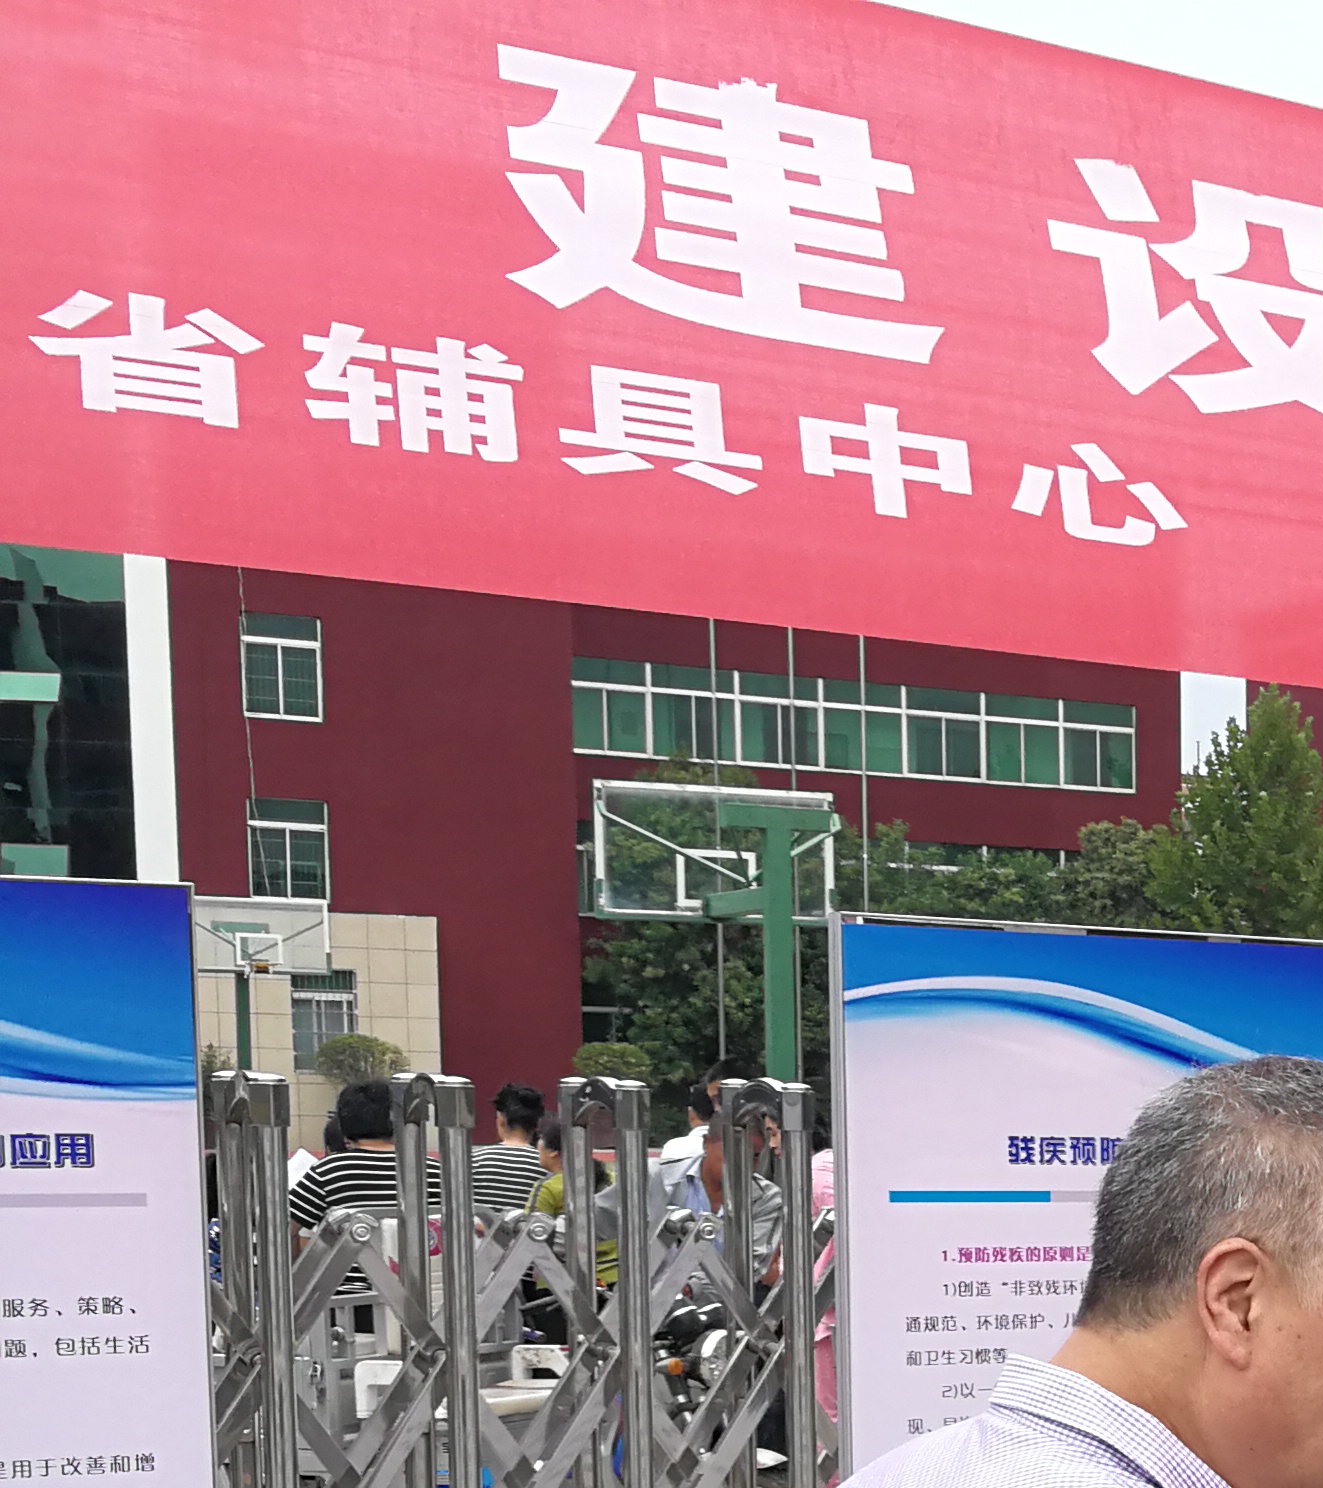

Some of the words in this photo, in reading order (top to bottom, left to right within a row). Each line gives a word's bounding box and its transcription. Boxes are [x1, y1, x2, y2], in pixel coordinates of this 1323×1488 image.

[29, 290, 1188, 548] 省辅具中心
[0, 1132, 96, 1170] 应用
[0, 1334, 150, 1359] 题，包括生活
